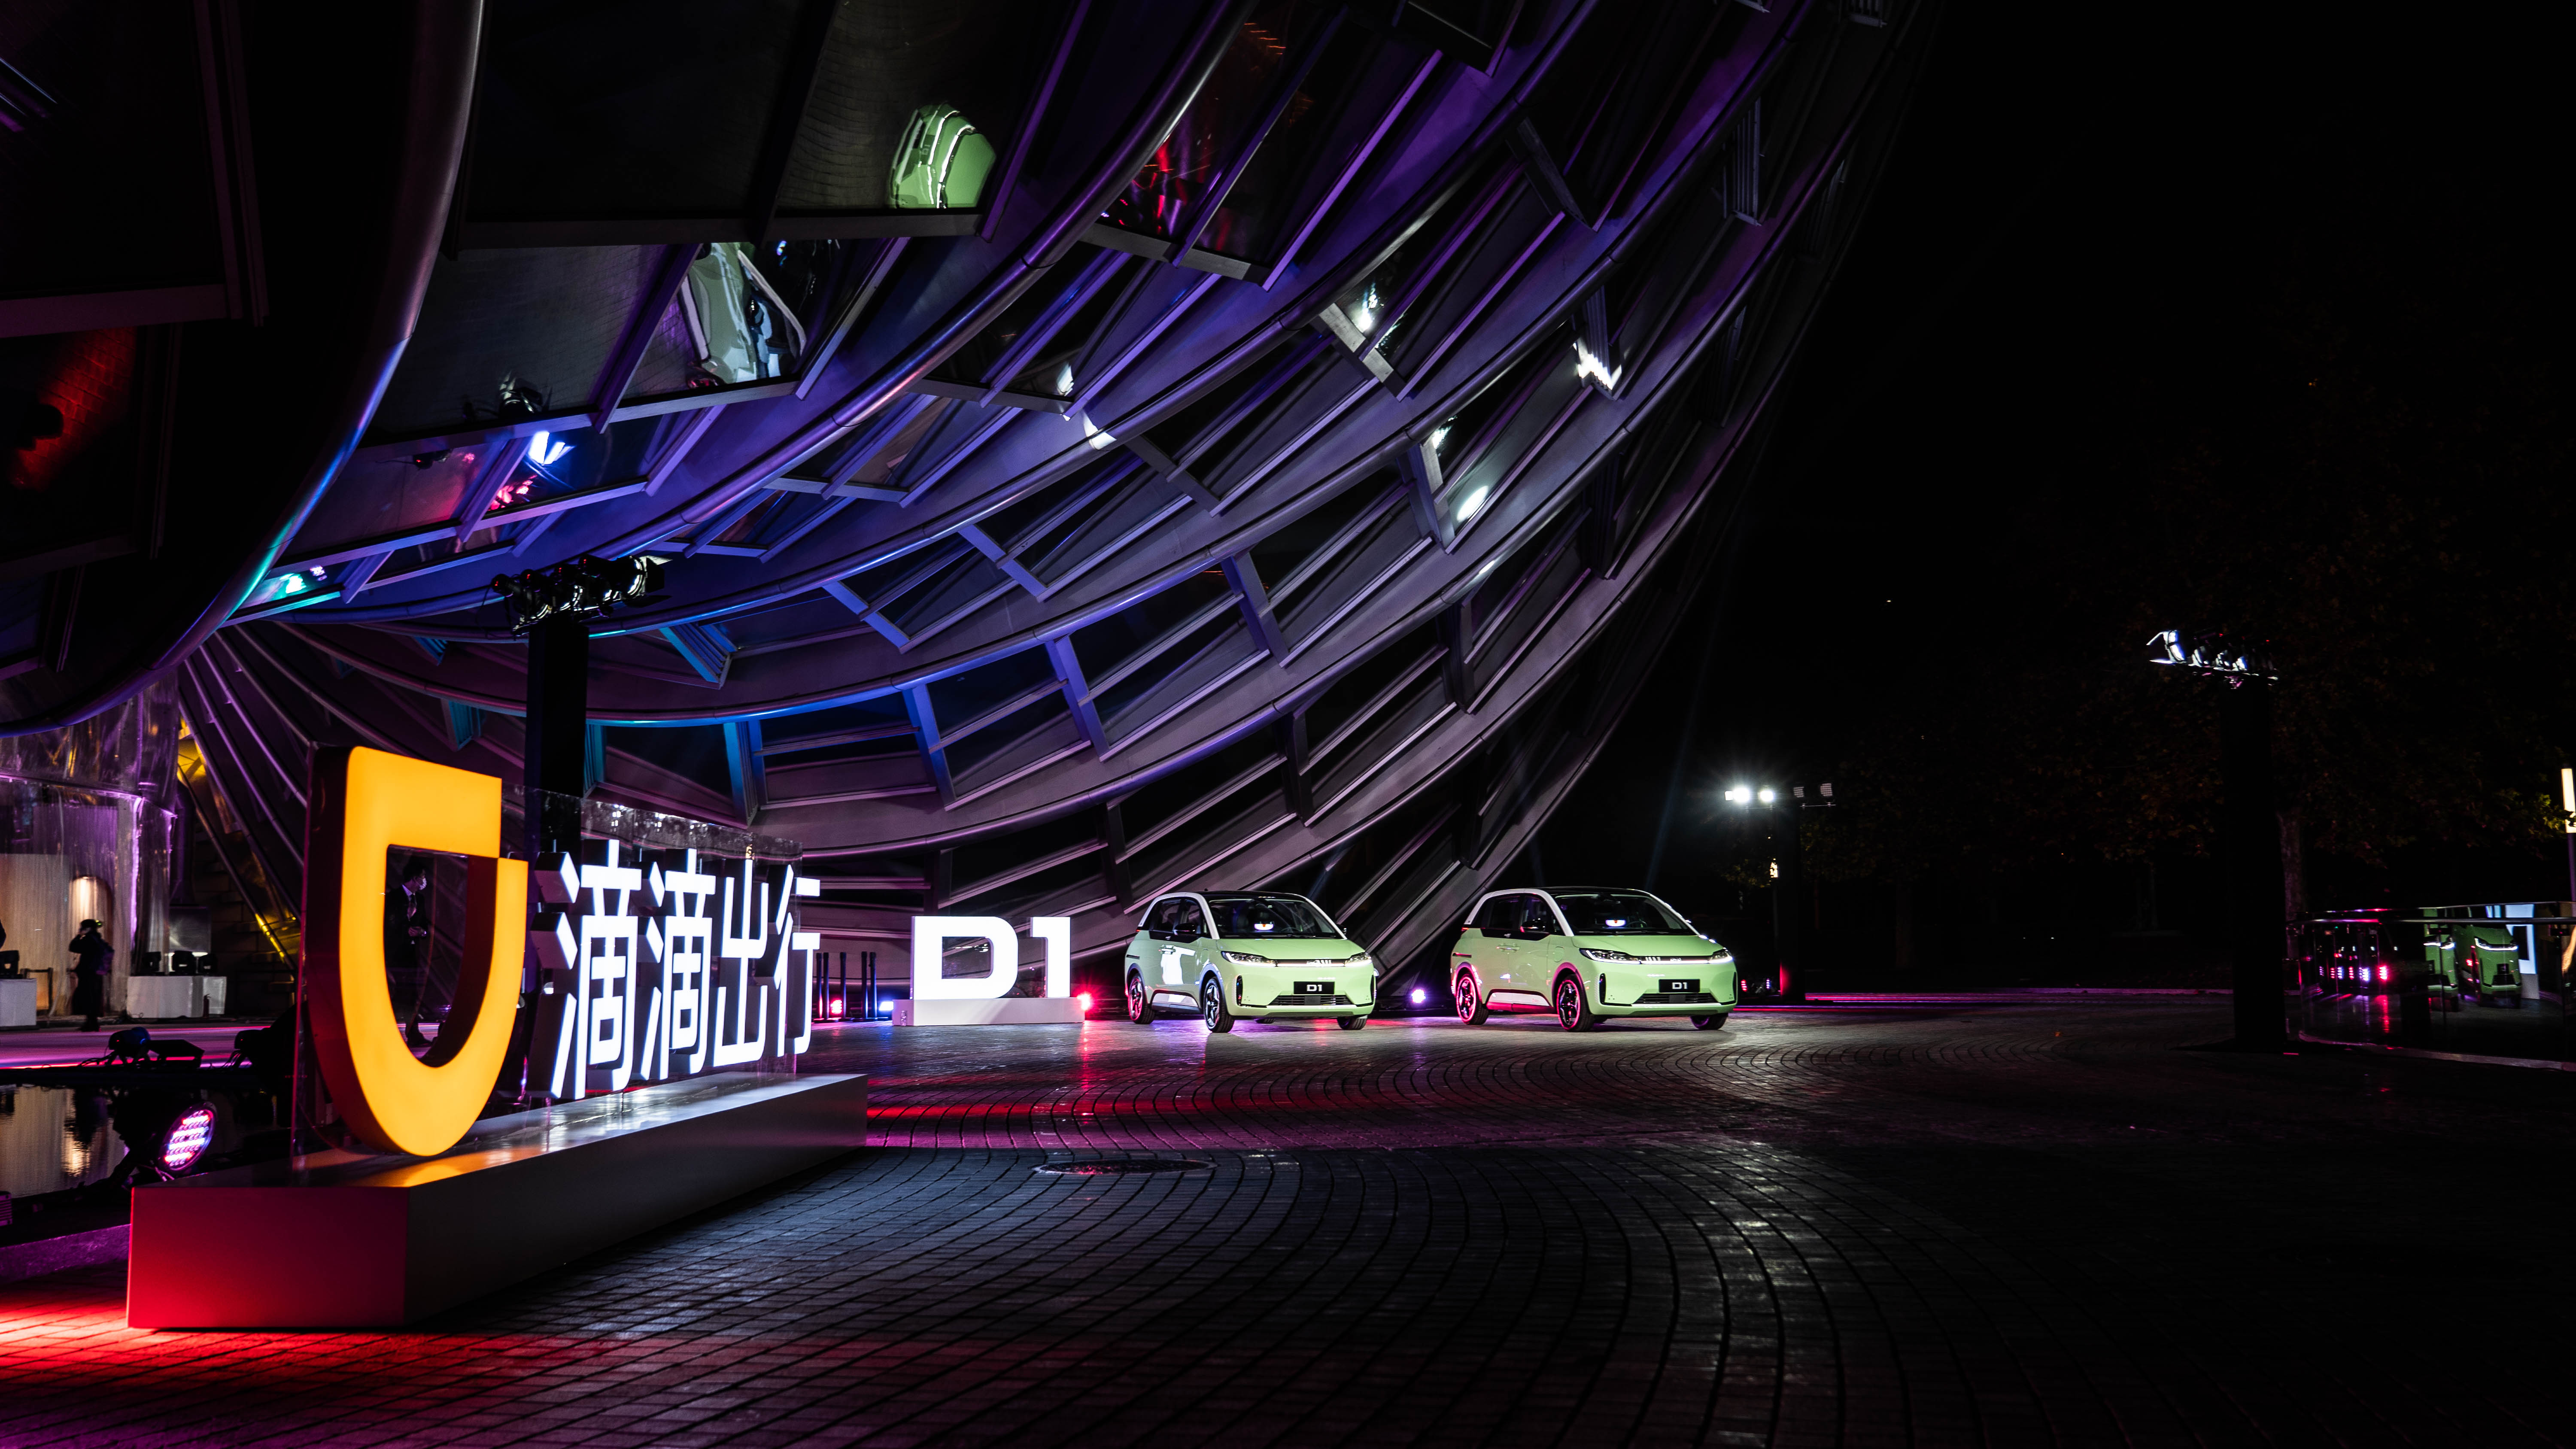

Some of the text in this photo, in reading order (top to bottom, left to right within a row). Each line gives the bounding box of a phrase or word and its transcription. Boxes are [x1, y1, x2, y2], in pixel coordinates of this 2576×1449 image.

[551, 839, 820, 1100] 滴滴出行
[913, 916, 1071, 1000] D1
